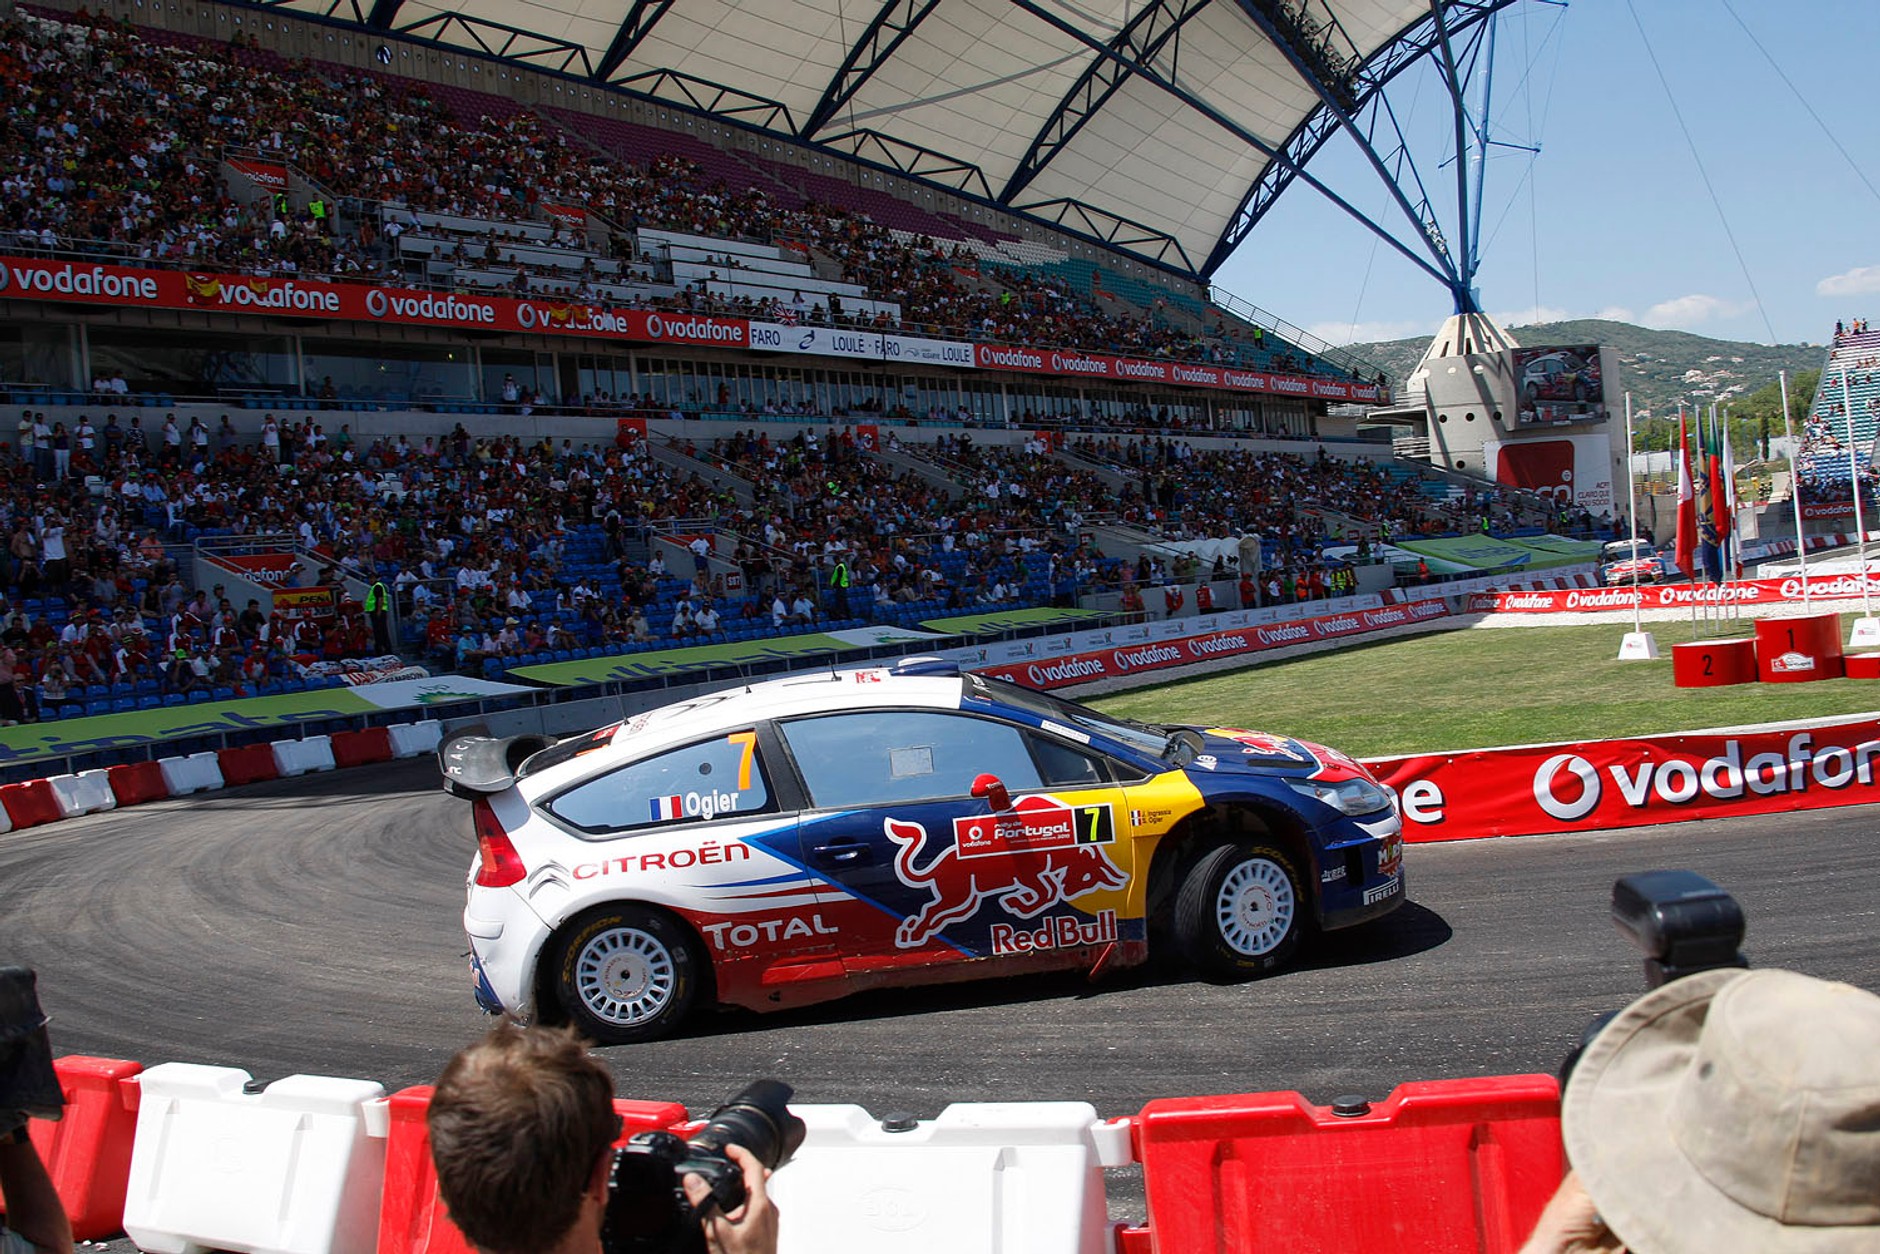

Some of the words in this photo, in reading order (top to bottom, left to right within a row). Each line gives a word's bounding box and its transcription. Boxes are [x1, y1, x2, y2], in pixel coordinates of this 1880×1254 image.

[13, 264, 158, 299] vodafone
[391, 292, 495, 324] vodafone
[664, 316, 743, 341] vodafone
[752, 328, 781, 346] FARO
[833, 334, 865, 354] LOULÉ
[942, 345, 970, 363] LOULÉ
[992, 350, 1042, 368] vodafone
[1061, 354, 1107, 373] vodafone
[1124, 361, 1165, 378] vodafone
[1180, 367, 1217, 384] vodafone
[1231, 374, 1264, 389] vodafone
[1277, 378, 1307, 393] vodafone
[1318, 383, 1346, 397] vodafone
[1513, 593, 1553, 609] vodafone
[1579, 590, 1643, 606] vodafone
[1371, 607, 1405, 624] vodafone
[1416, 602, 1446, 616] vodafone
[1266, 624, 1310, 641] vodafone
[1323, 616, 1360, 633] vodafone
[1199, 634, 1248, 653] vodafone
[1787, 628, 1795, 650] 1
[1127, 644, 1181, 666] vodafone
[1042, 657, 1105, 681] vodafone
[1703, 655, 1714, 676] 2
[728, 731, 757, 791] 7
[686, 790, 739, 820] Ogier
[994, 821, 1071, 840] Portugal
[1084, 808, 1100, 842] 7
[962, 840, 992, 848] vodafone
[572, 841, 751, 880] CITROËN
[1363, 877, 1399, 906] PIRELLI
[702, 913, 839, 951] TOTAL
[991, 916, 1053, 956] Red
[1058, 908, 1118, 945] Bull
